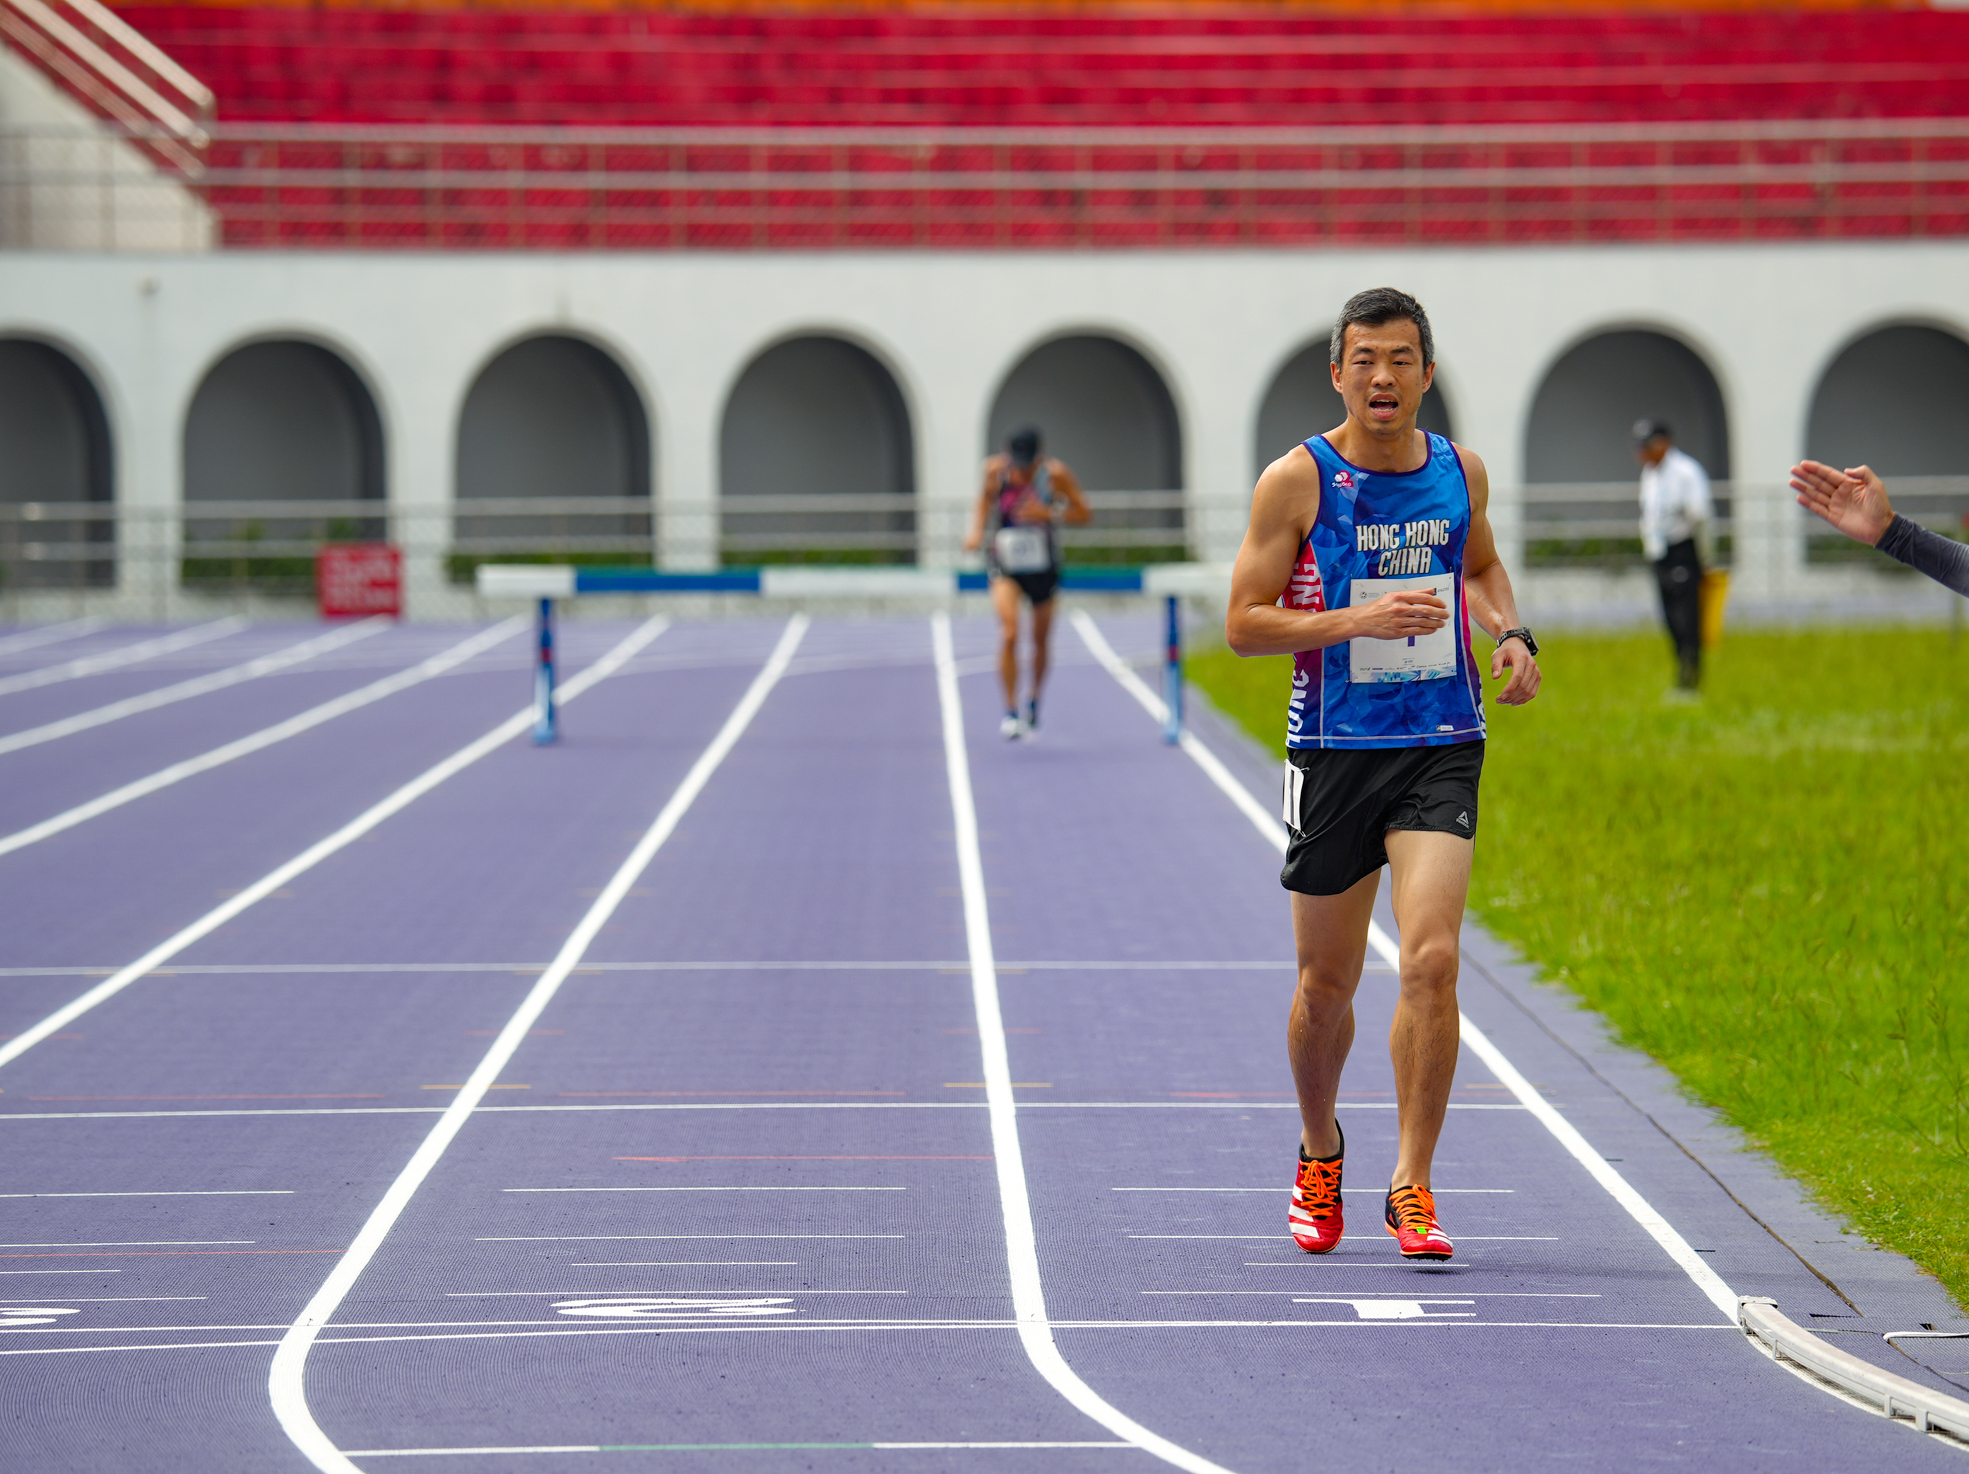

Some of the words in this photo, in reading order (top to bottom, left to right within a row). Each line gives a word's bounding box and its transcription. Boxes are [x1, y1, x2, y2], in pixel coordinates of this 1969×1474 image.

[1356, 523, 1400, 551] HONG
[1404, 519, 1450, 547] KONG
[1378, 546, 1432, 577] CHINA
